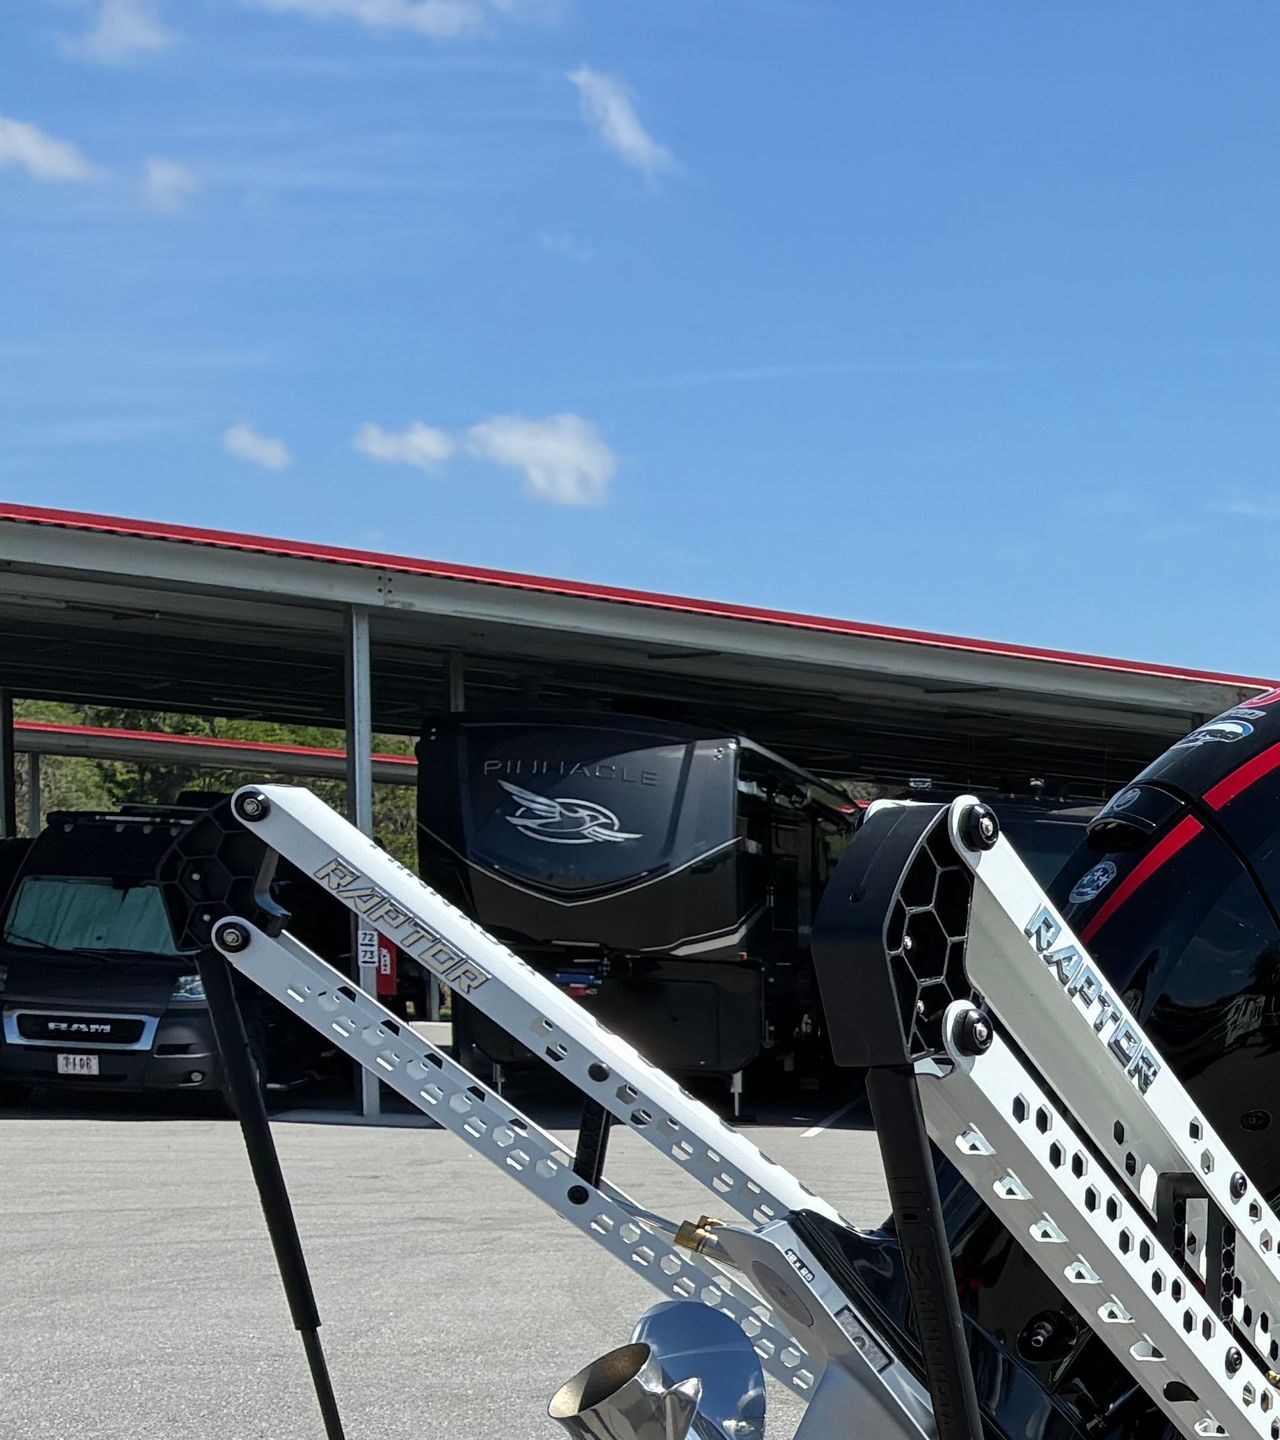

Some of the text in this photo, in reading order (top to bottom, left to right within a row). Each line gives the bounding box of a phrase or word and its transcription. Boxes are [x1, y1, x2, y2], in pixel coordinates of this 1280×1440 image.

[484, 760, 658, 787] PINNACLE
[314, 857, 492, 994] RAPTOR
[361, 932, 375, 943] 72
[361, 950, 375, 960] 73
[1024, 903, 1161, 1096] RAPTOR
[48, 1022, 111, 1033] RAM
